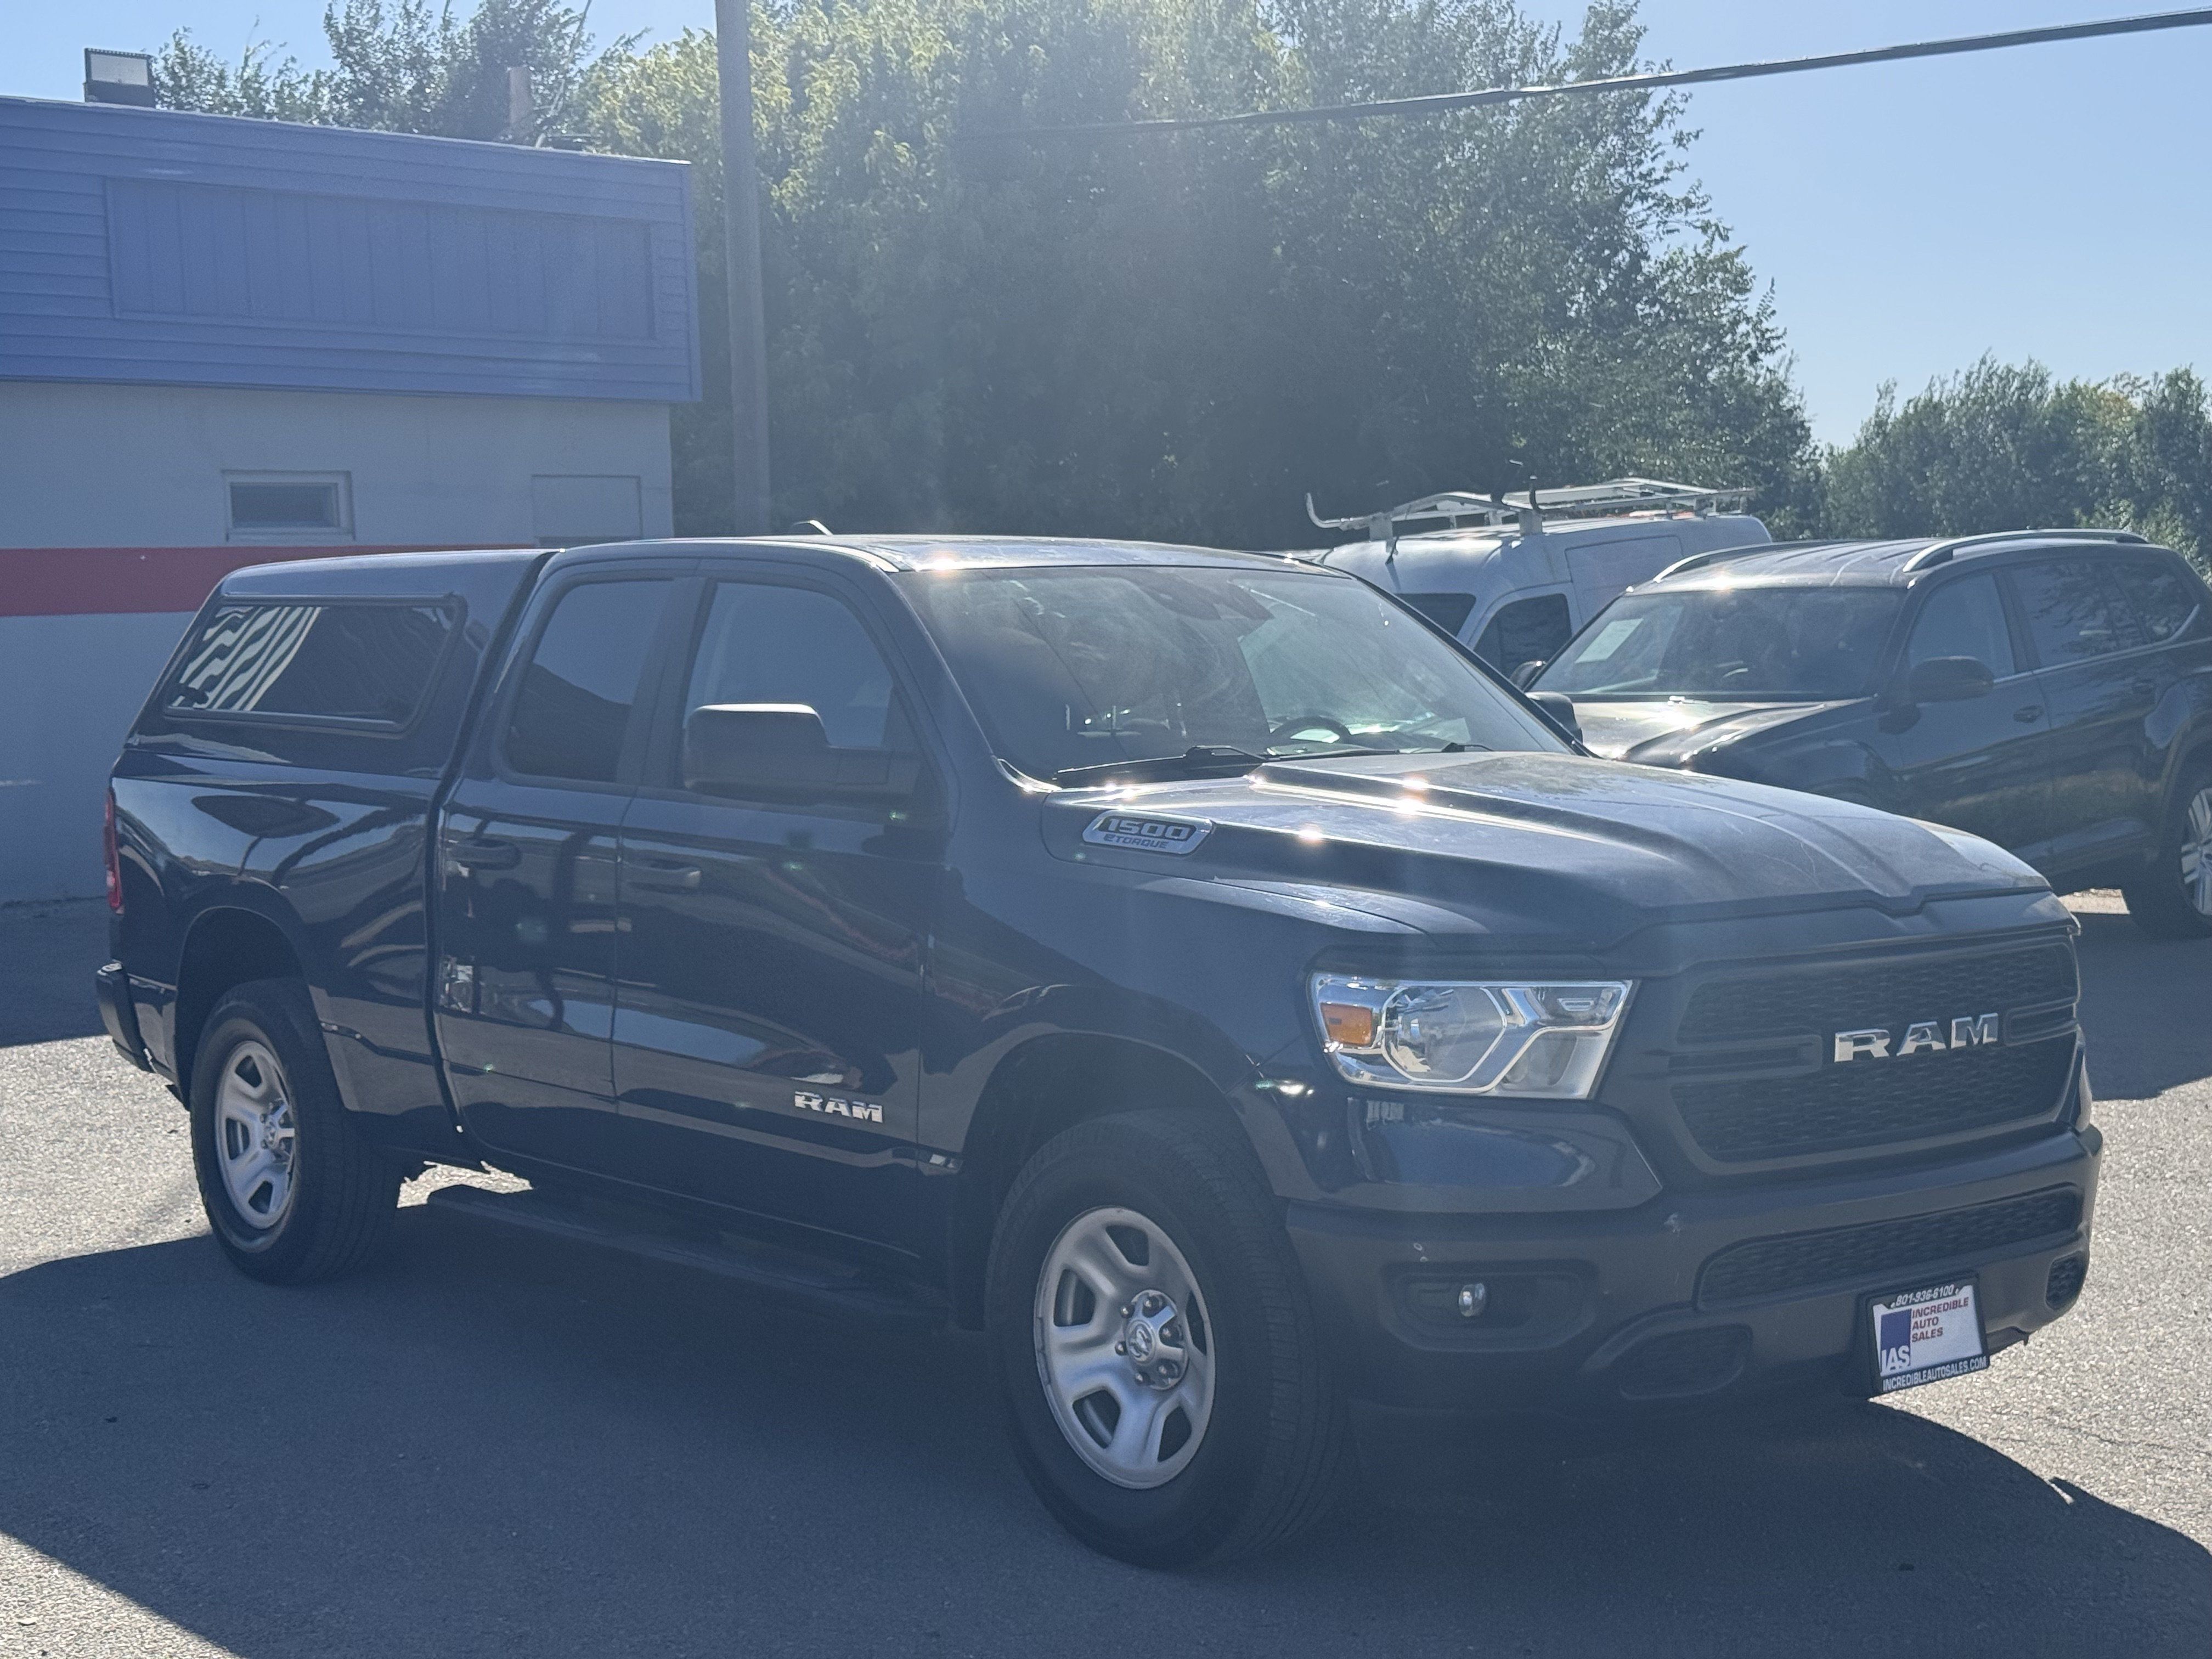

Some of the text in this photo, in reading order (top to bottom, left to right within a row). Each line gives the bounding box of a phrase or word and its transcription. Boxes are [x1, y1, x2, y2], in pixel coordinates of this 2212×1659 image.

[1108, 818, 1190, 839] 1500
[1834, 1013, 1999, 1063] RAM
[795, 1091, 883, 1123] RAM
[1895, 1284, 1954, 1306] 801-936-6100
[1912, 1297, 1969, 1319] INCREDIBLE
[1912, 1317, 1939, 1331] AUTO
[1912, 1327, 1943, 1342] SALES
[1881, 1345, 1910, 1373] IAS
[1883, 1356, 1987, 1391] INCREDIBLEAUTOSALES.COM
